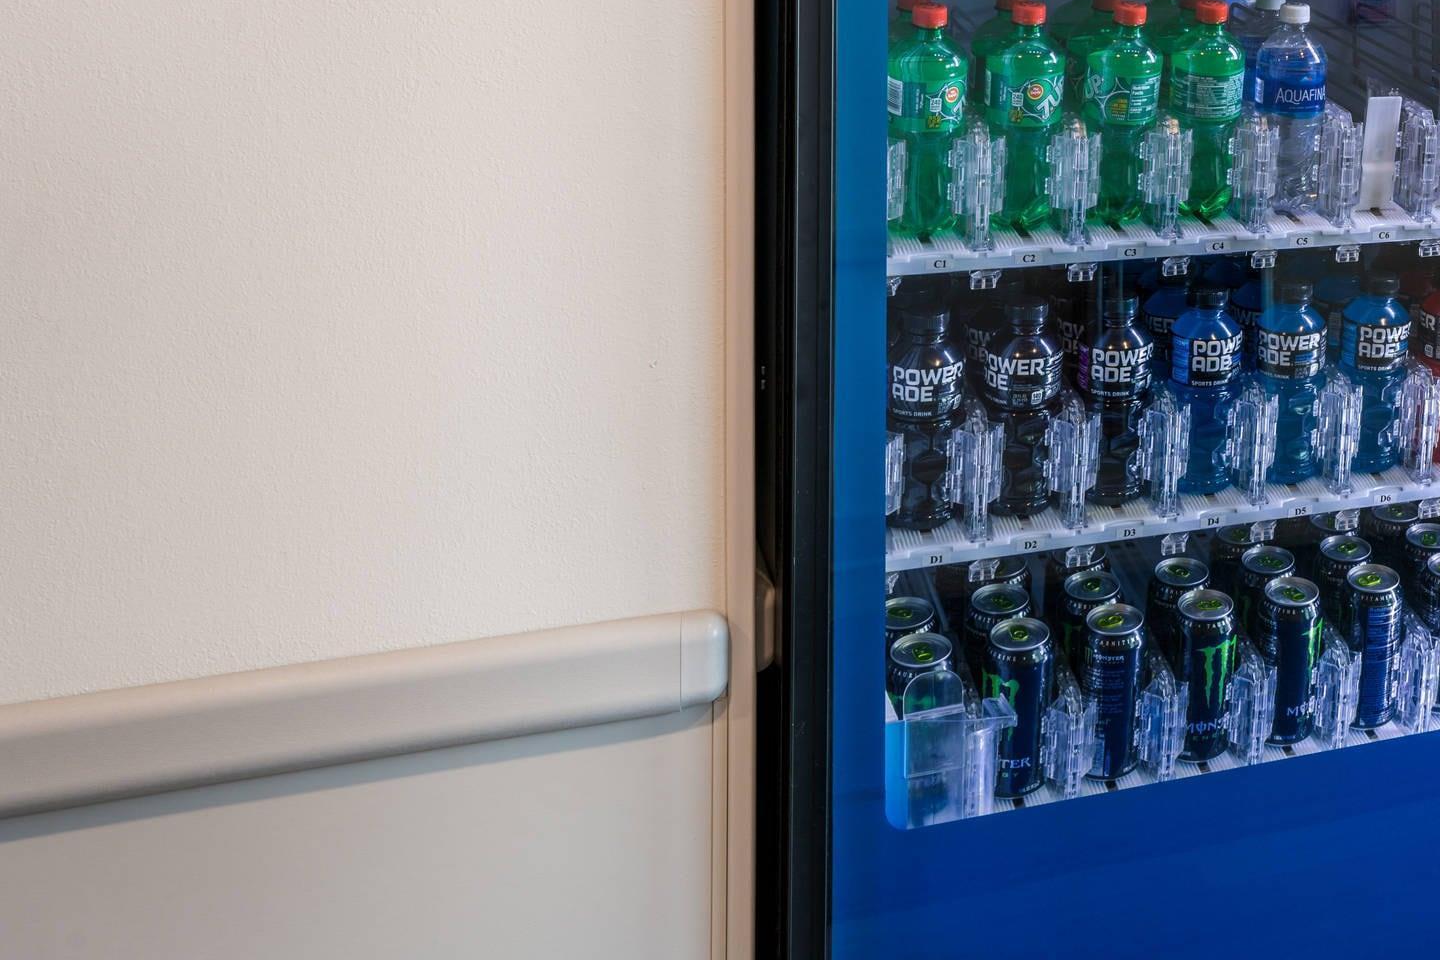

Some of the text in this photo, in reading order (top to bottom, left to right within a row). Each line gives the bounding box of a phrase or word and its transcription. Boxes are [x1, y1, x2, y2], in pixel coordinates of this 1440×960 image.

[1378, 230, 1390, 240] C6
[1212, 241, 1225, 251] C4
[1296, 237, 1308, 246] C5
[1124, 248, 1137, 257] C3
[1022, 254, 1036, 263] C2
[933, 259, 947, 269] C1
[1258, 330, 1320, 352] POWER
[1092, 342, 1154, 366] POWER
[1358, 341, 1394, 358] ADE
[1192, 356, 1232, 372] ADE
[893, 360, 965, 386] POWER
[1090, 365, 1132, 383] ADE
[892, 384, 934, 402] ADE
[1380, 493, 1392, 503] D6
[1294, 506, 1307, 516] D5
[1207, 516, 1220, 527] D4
[1123, 527, 1136, 537] D3
[1024, 540, 1038, 550] D2
[930, 555, 943, 565] D1
